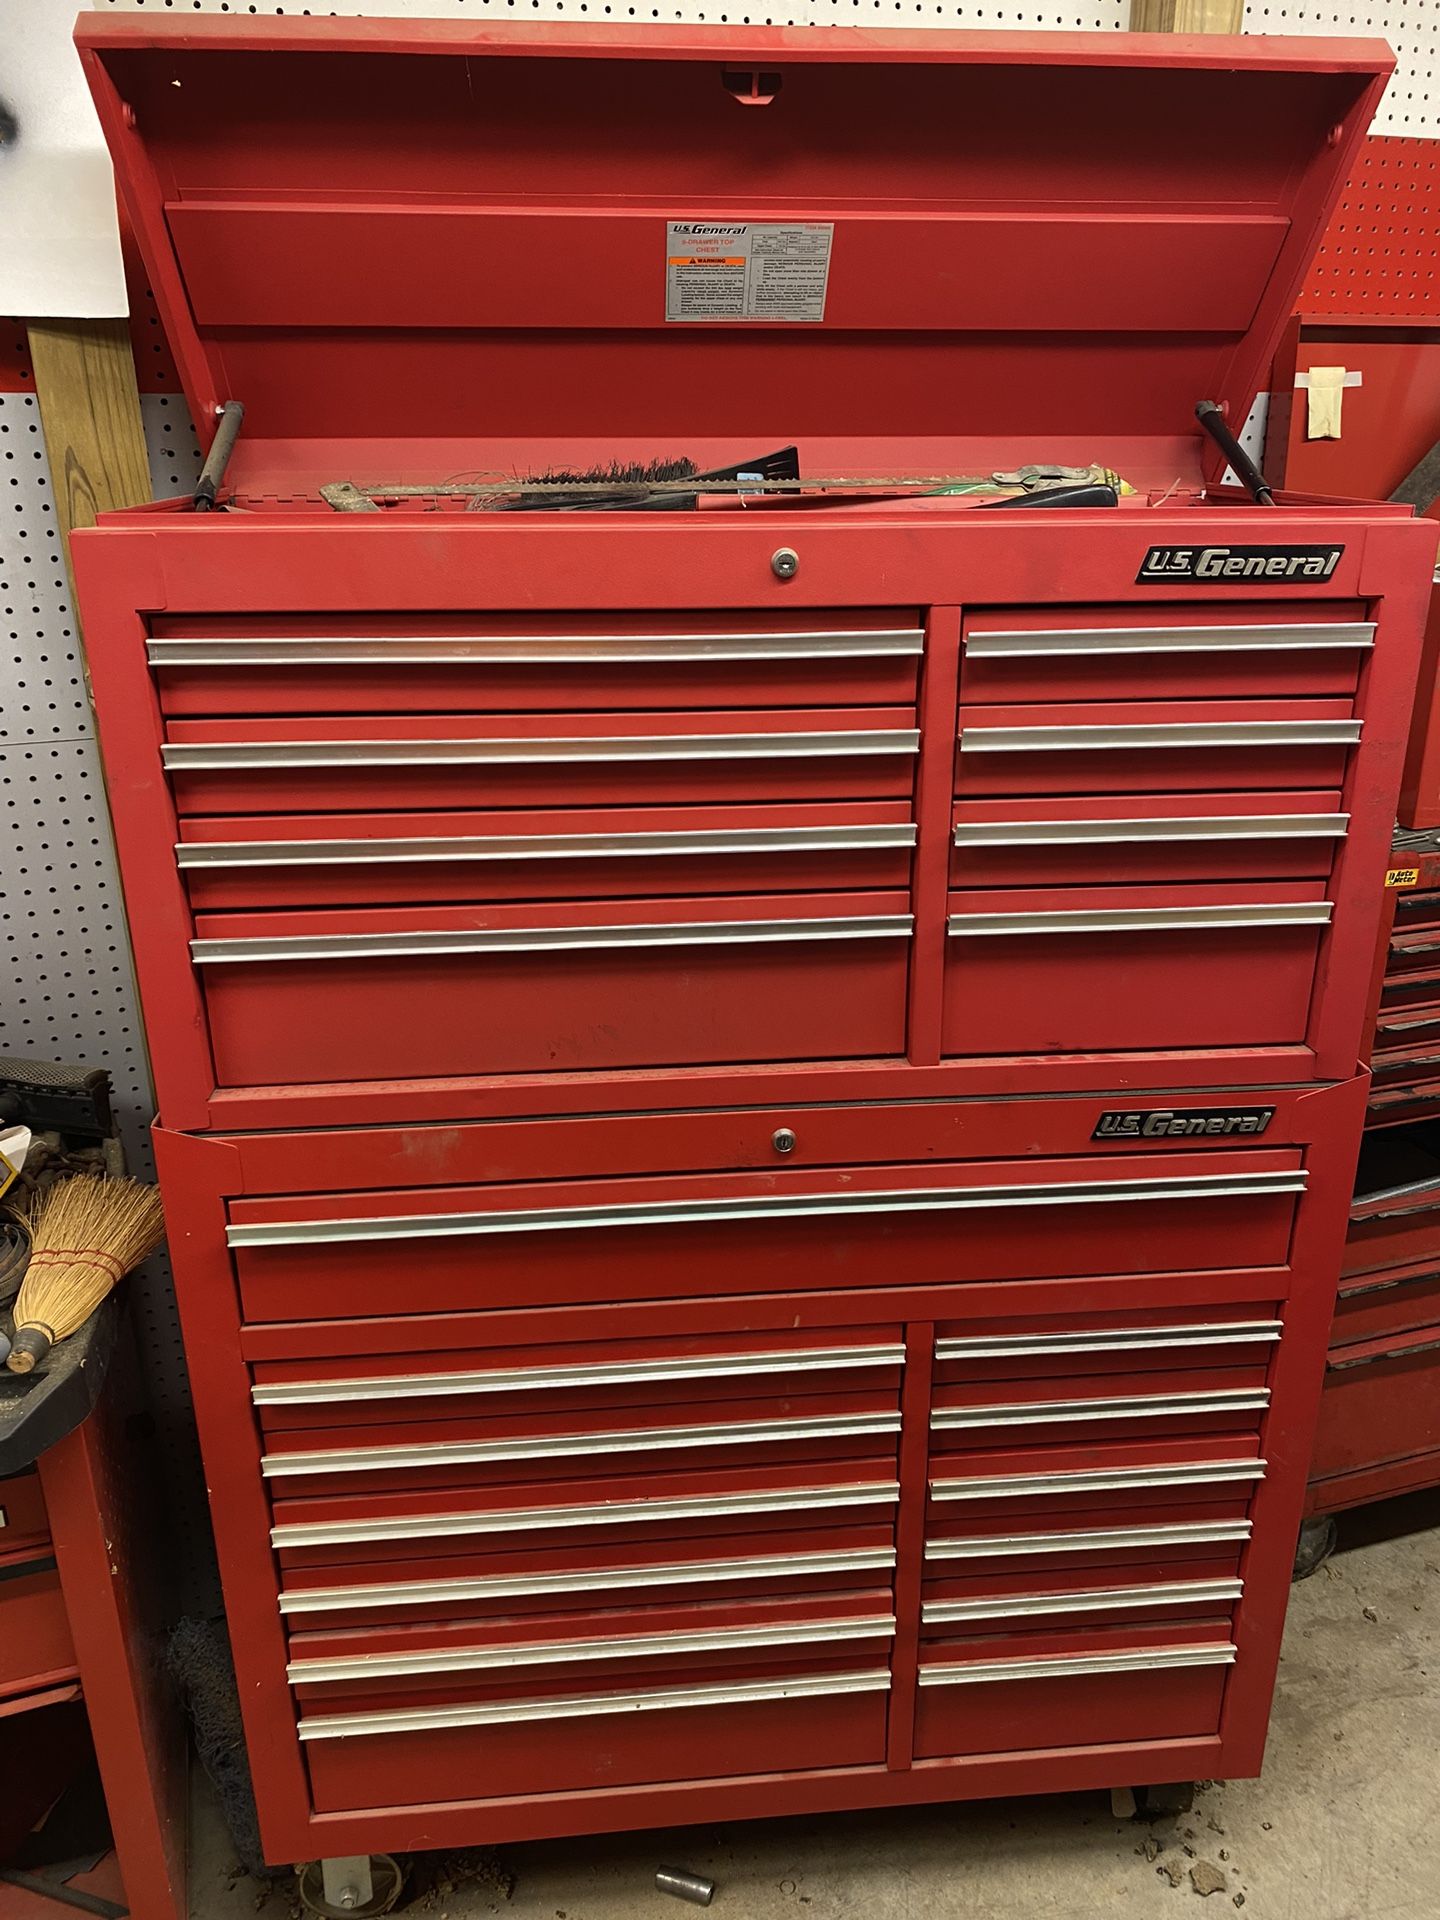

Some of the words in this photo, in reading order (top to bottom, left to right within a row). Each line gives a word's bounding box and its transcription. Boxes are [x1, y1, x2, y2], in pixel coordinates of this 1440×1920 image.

[691, 224, 748, 235] General
[1194, 548, 1341, 577] General
[1142, 1112, 1273, 1137] General
